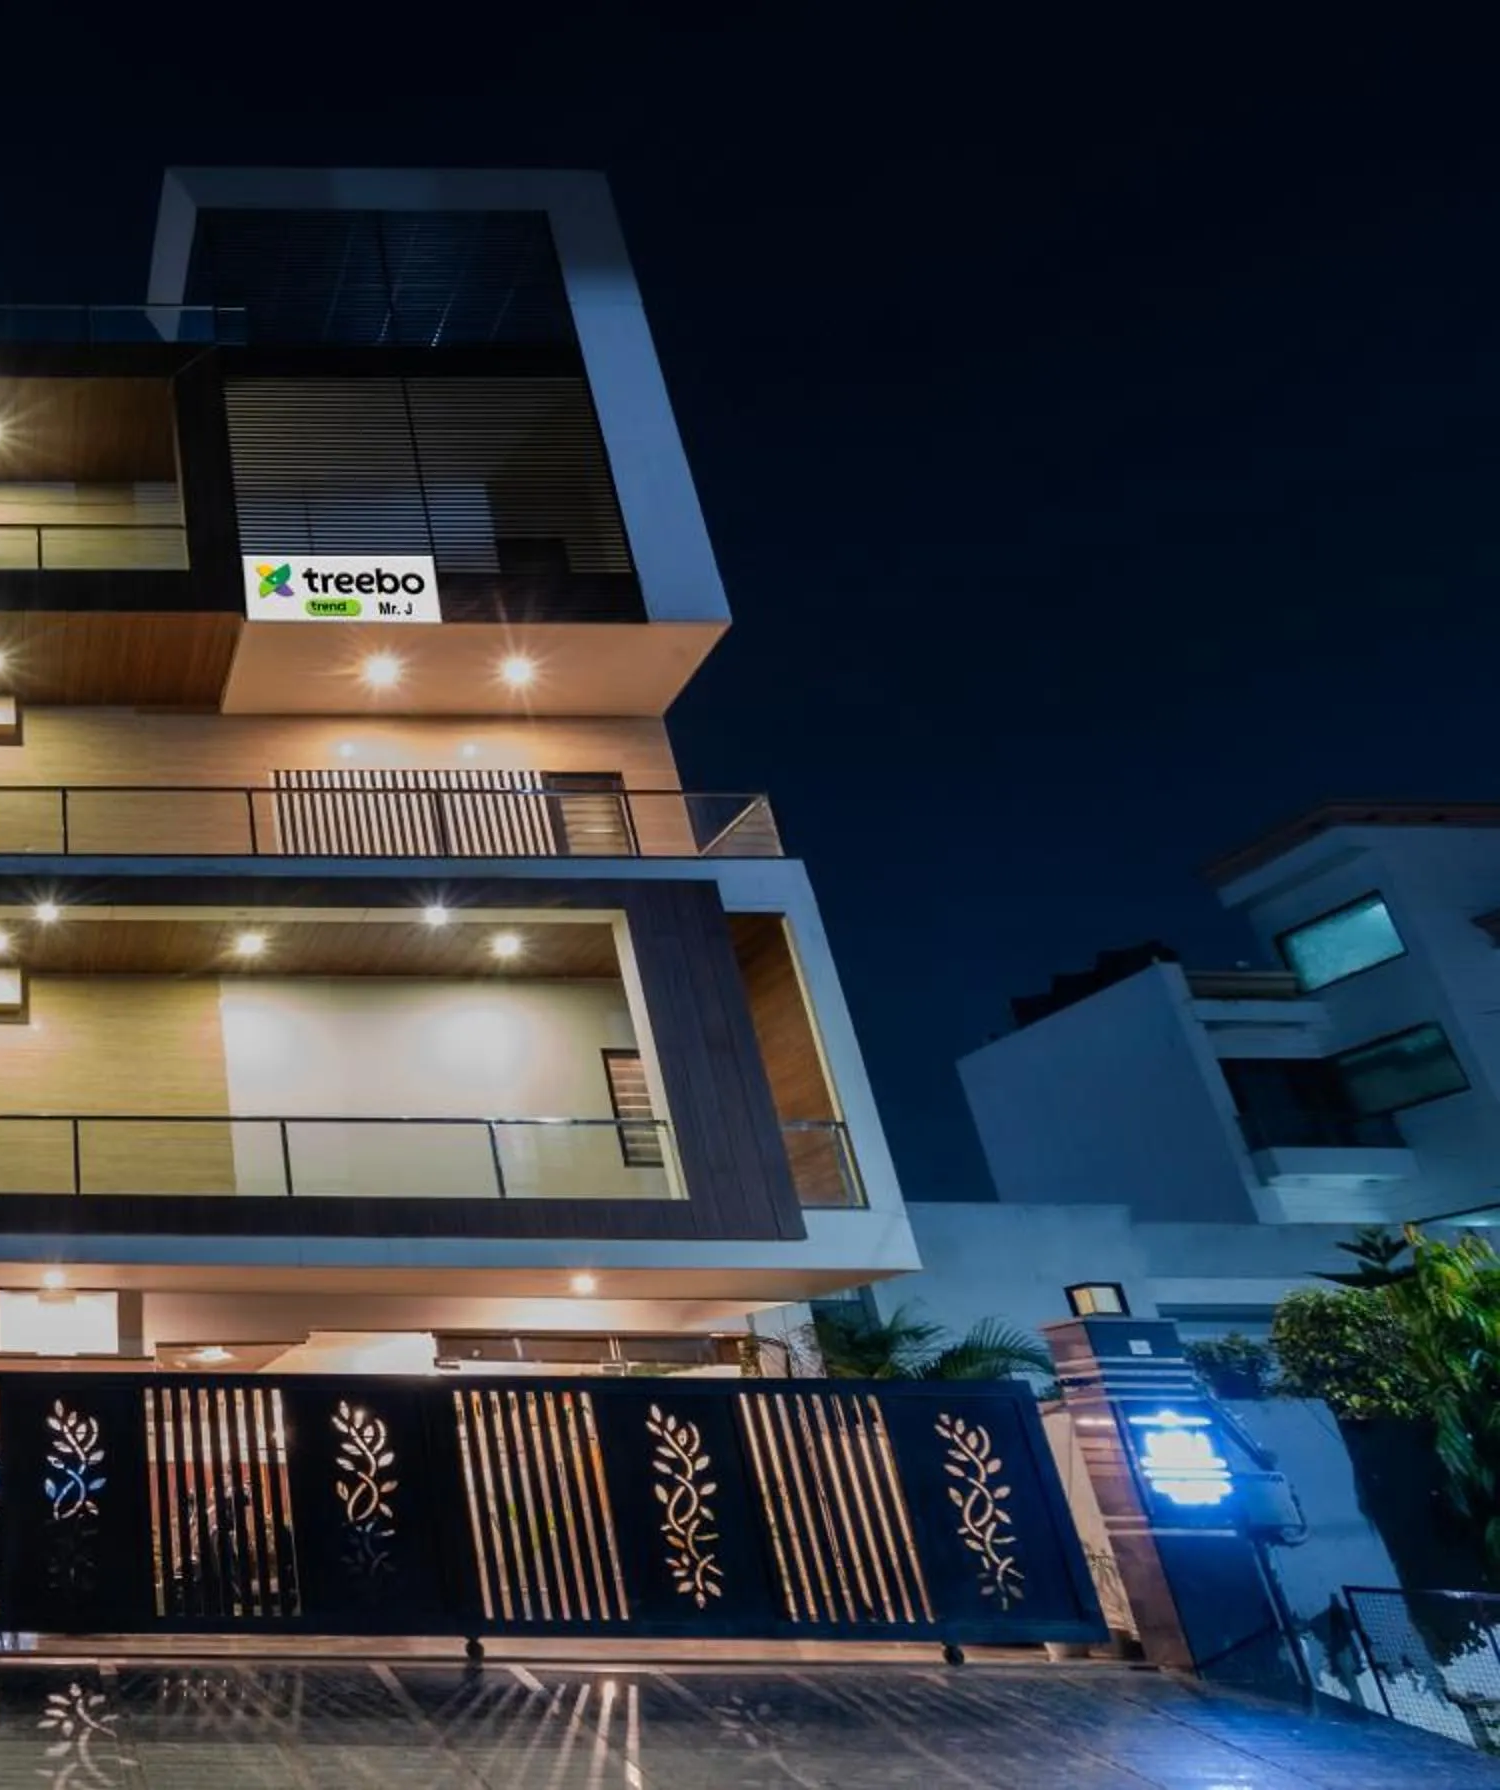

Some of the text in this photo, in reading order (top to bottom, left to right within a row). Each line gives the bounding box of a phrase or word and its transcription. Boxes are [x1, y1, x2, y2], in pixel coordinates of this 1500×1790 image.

[303, 568, 425, 594] treebo
[311, 601, 346, 611] trend
[379, 602, 413, 615] Mr. J
